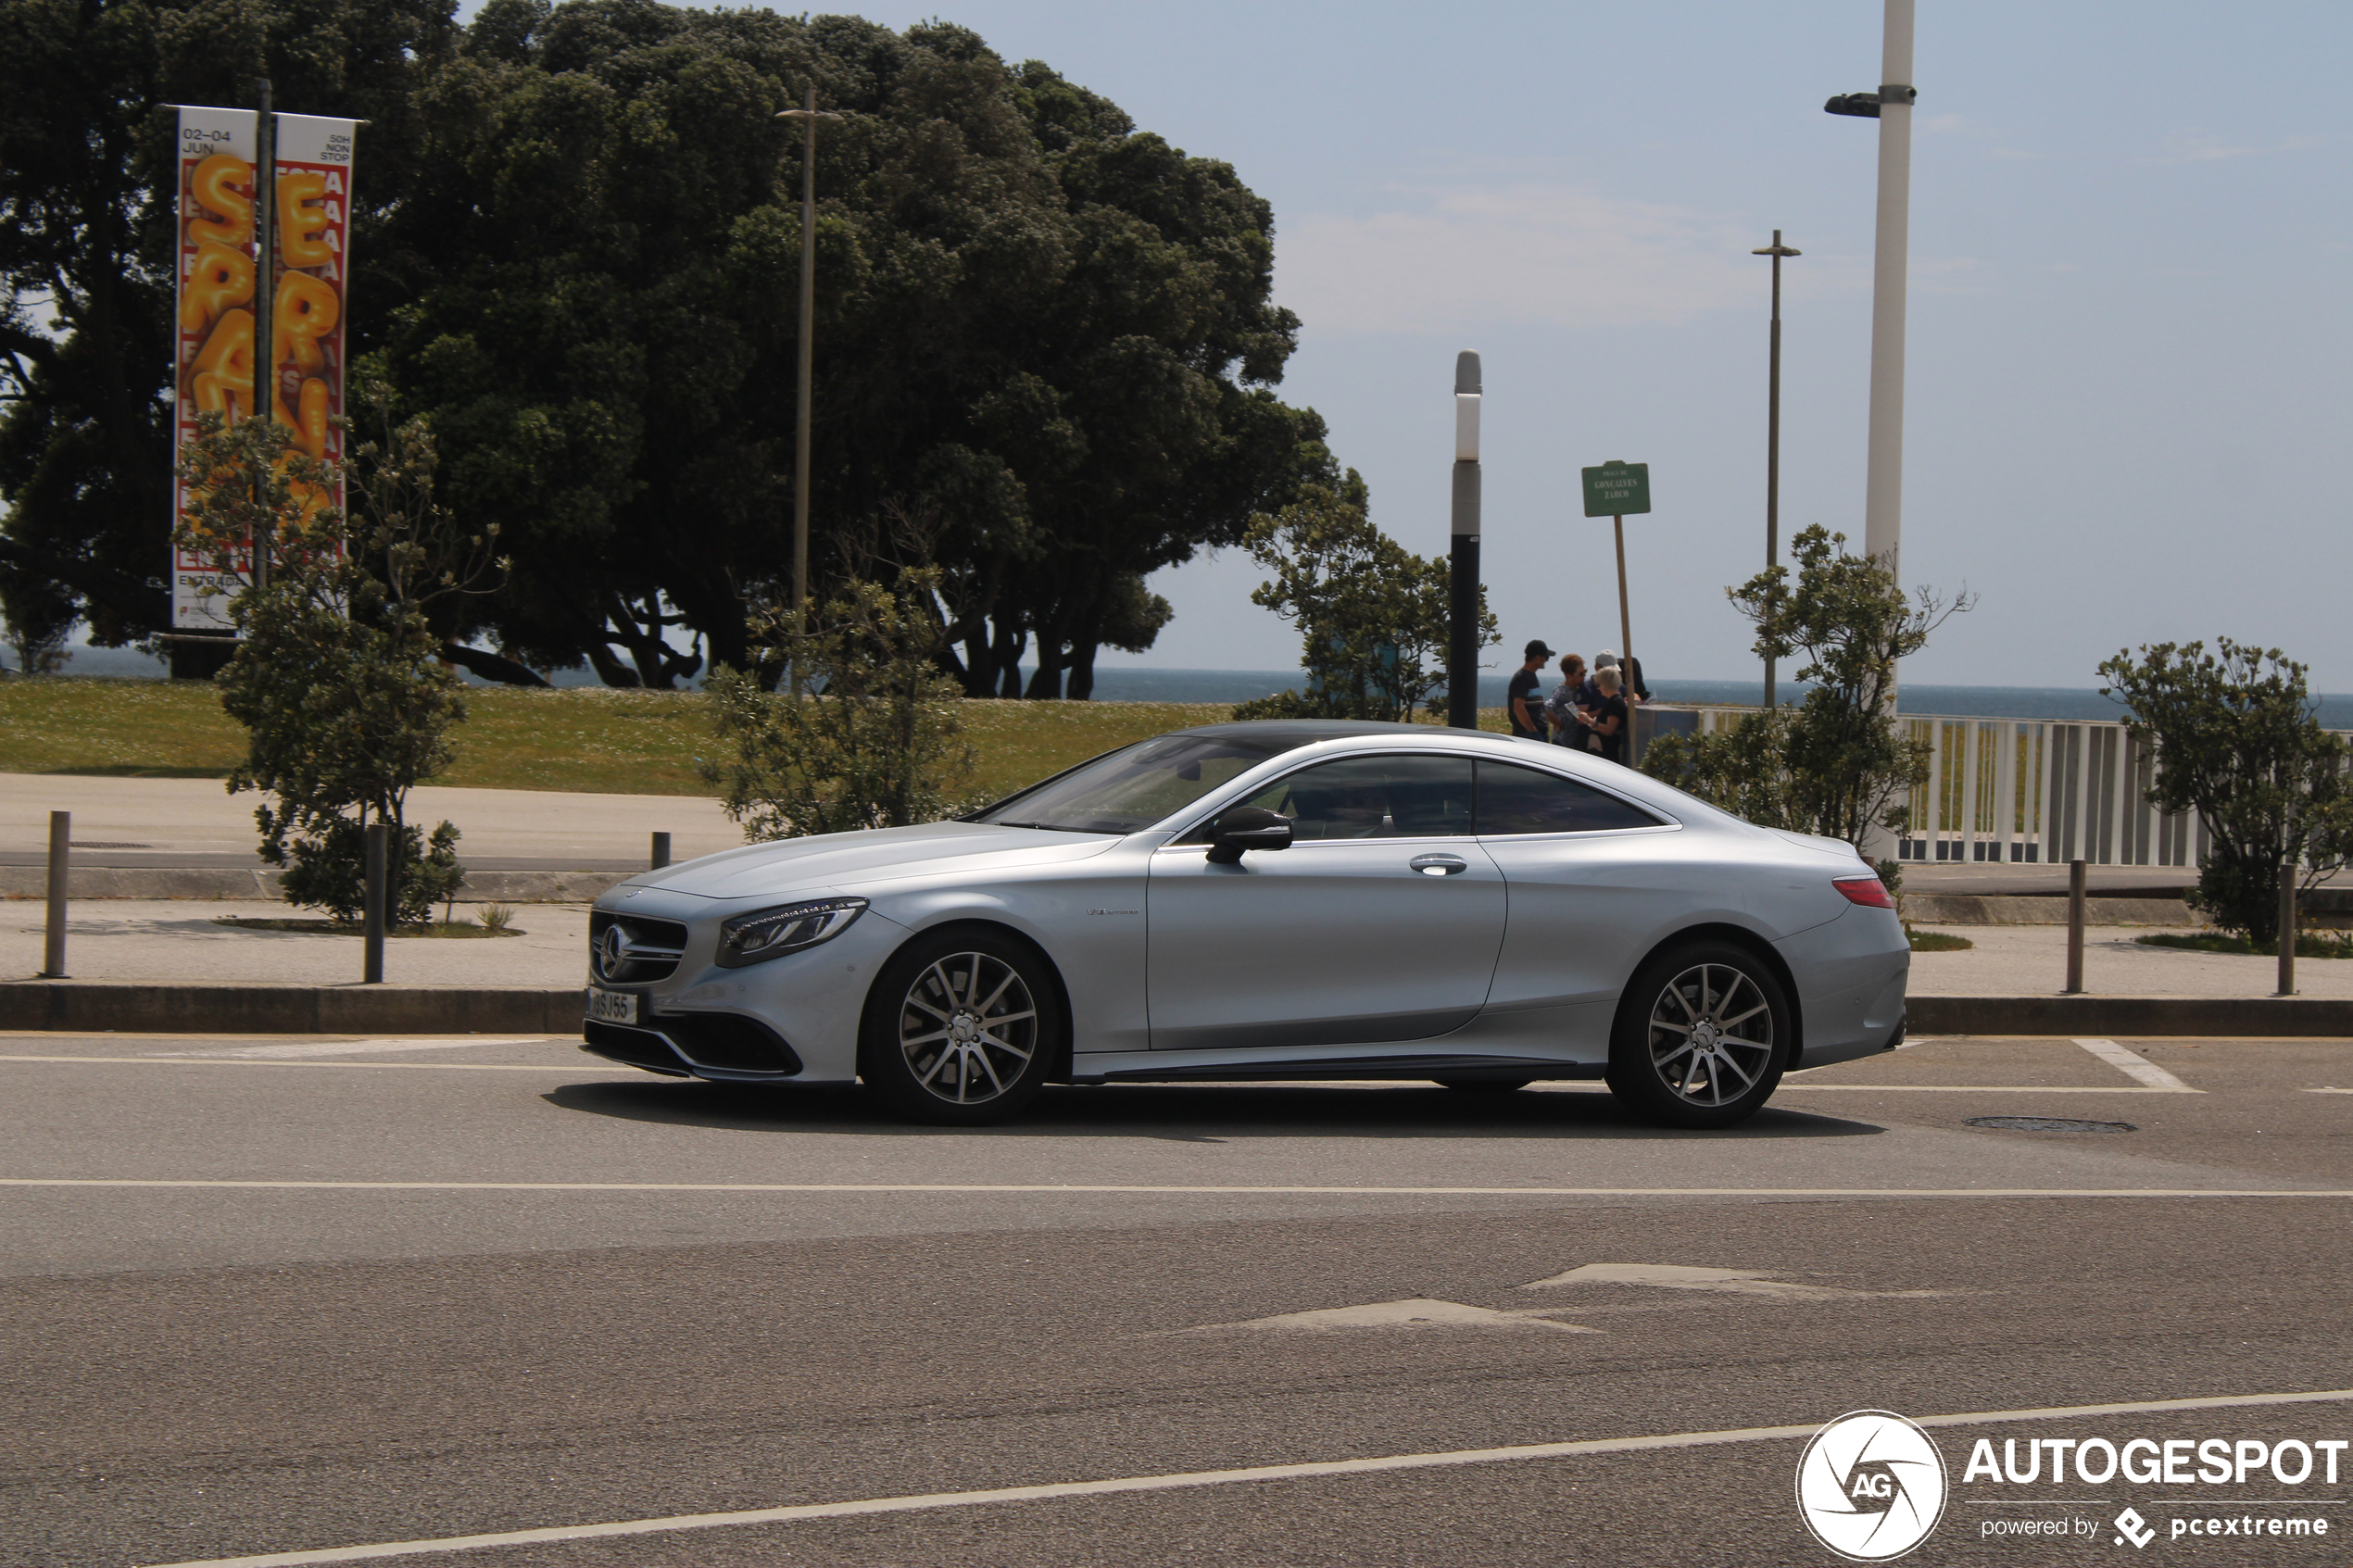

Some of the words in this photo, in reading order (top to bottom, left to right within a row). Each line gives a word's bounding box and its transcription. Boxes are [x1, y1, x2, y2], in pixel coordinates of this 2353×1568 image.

[182, 143, 215, 156] JUN
[326, 144, 350, 154] NON
[320, 151, 350, 162] STOP
[1604, 490, 1629, 499] ZARCO
